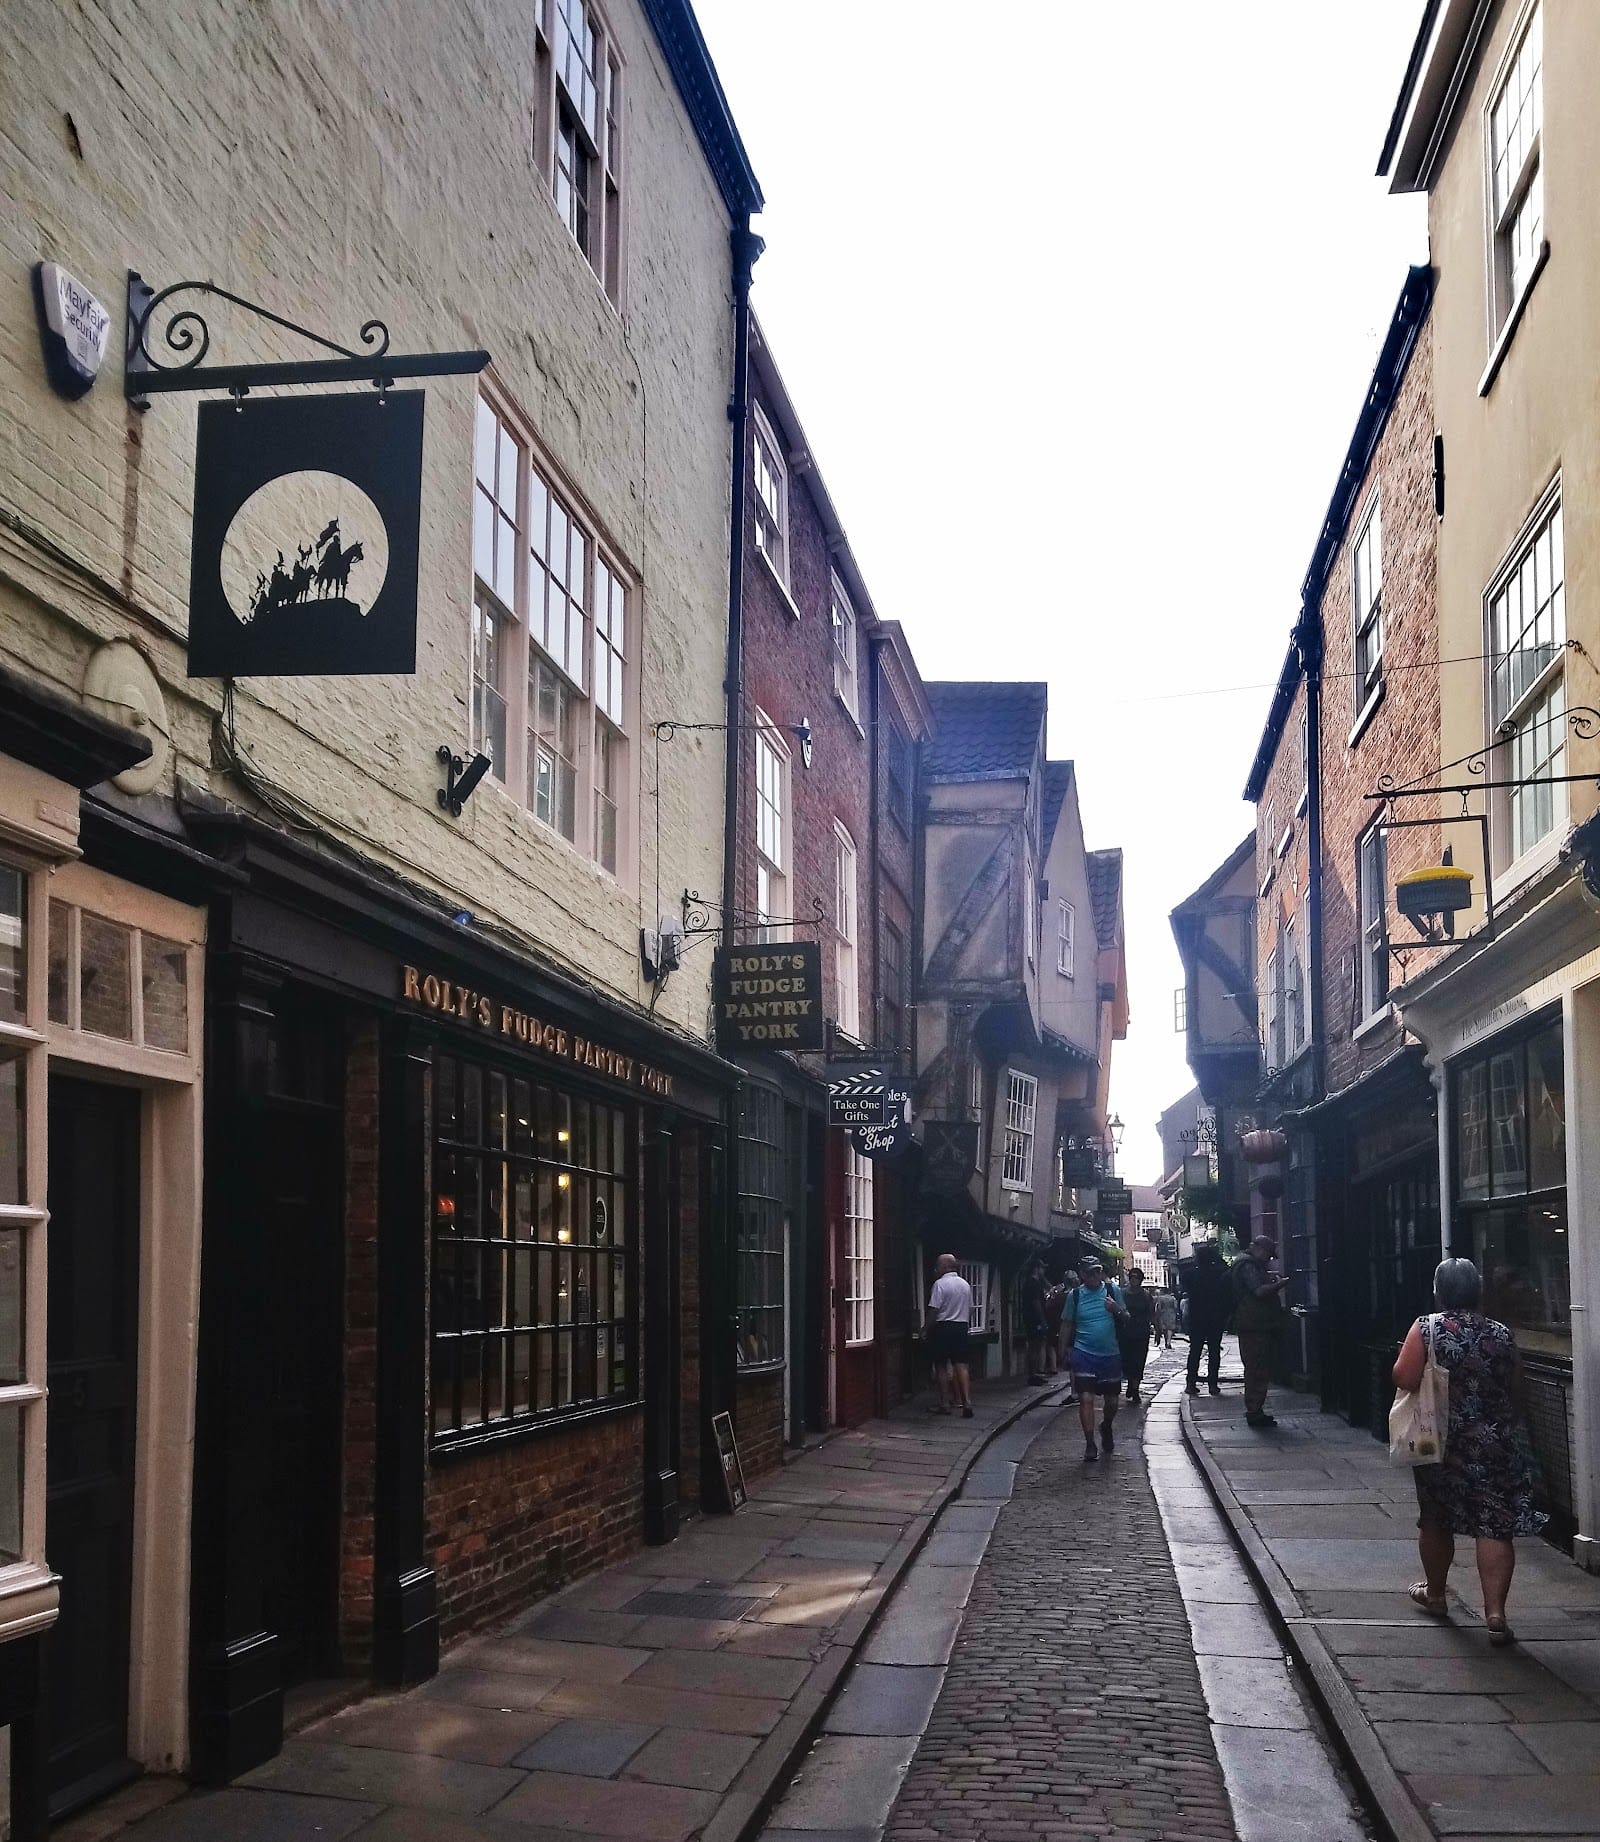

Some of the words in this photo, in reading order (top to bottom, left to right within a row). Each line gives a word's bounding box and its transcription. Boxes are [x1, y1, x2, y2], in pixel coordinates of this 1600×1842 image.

[60, 276, 105, 332] Mayfair
[64, 304, 101, 352] Security
[730, 954, 805, 974] ROLY'S
[730, 977, 806, 996] FUDGE
[724, 1000, 813, 1019] PANTRY
[402, 964, 492, 1028] ROLY'S
[501, 1005, 568, 1056] FUDGE
[574, 1035, 634, 1081] PANTRY
[639, 1063, 674, 1097] YORK
[739, 1023, 800, 1041] YORK
[832, 1099, 858, 1110] Take
[859, 1099, 881, 1110] One
[844, 1111, 870, 1121] Gifts
[864, 1133, 895, 1152] Shop
